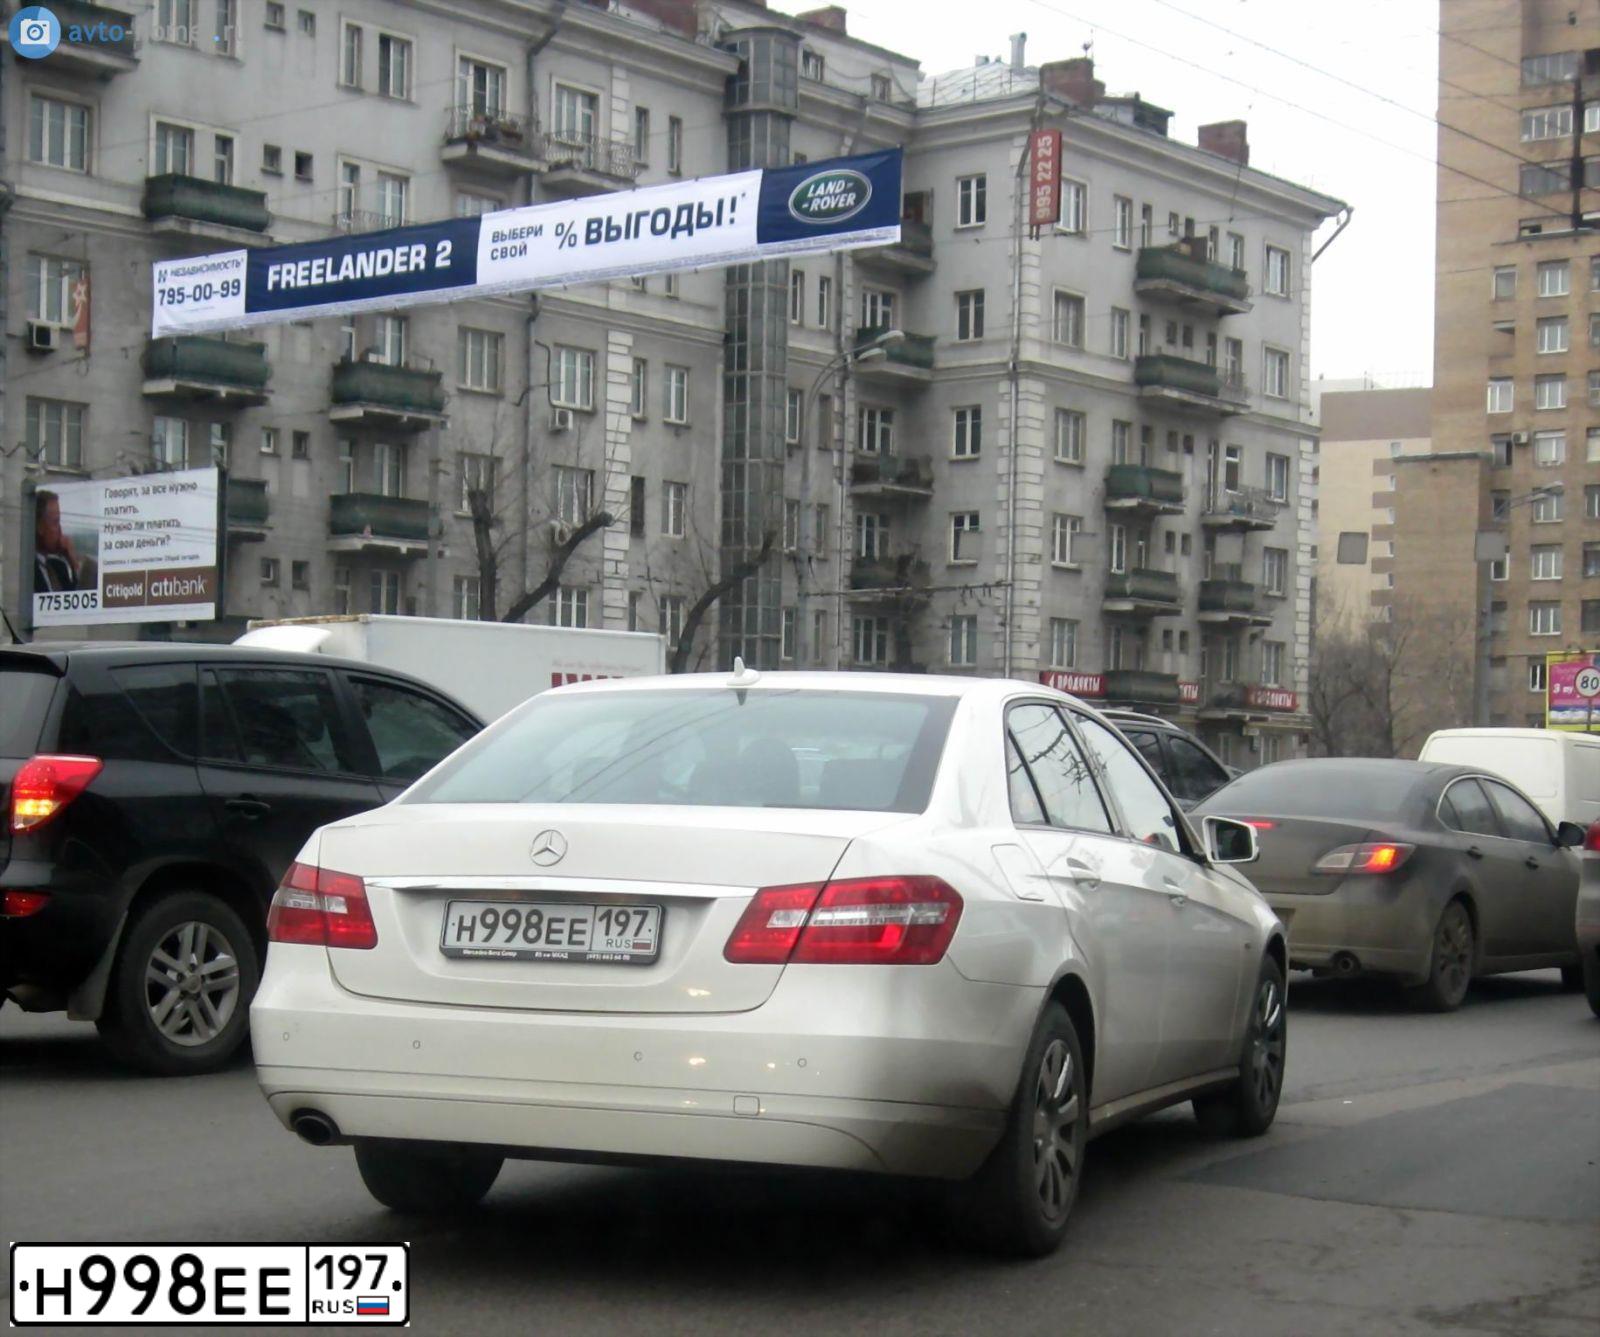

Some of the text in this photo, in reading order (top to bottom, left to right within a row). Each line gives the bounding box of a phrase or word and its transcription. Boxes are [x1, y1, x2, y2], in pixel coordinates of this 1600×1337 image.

[1036, 135, 1053, 219] 995 22 25
[491, 224, 544, 244] ВЫБЕРИ
[490, 242, 528, 261] СВОЙ
[266, 239, 453, 291] FREELANDER 2
[158, 278, 241, 306] 795-00-99
[141, 486, 151, 495] за
[152, 485, 167, 495] все
[168, 482, 198, 495] нужно
[106, 582, 143, 600] Citigold
[1580, 675, 1599, 690] 80
[598, 909, 649, 938] 197
[605, 939, 632, 949] RUS
